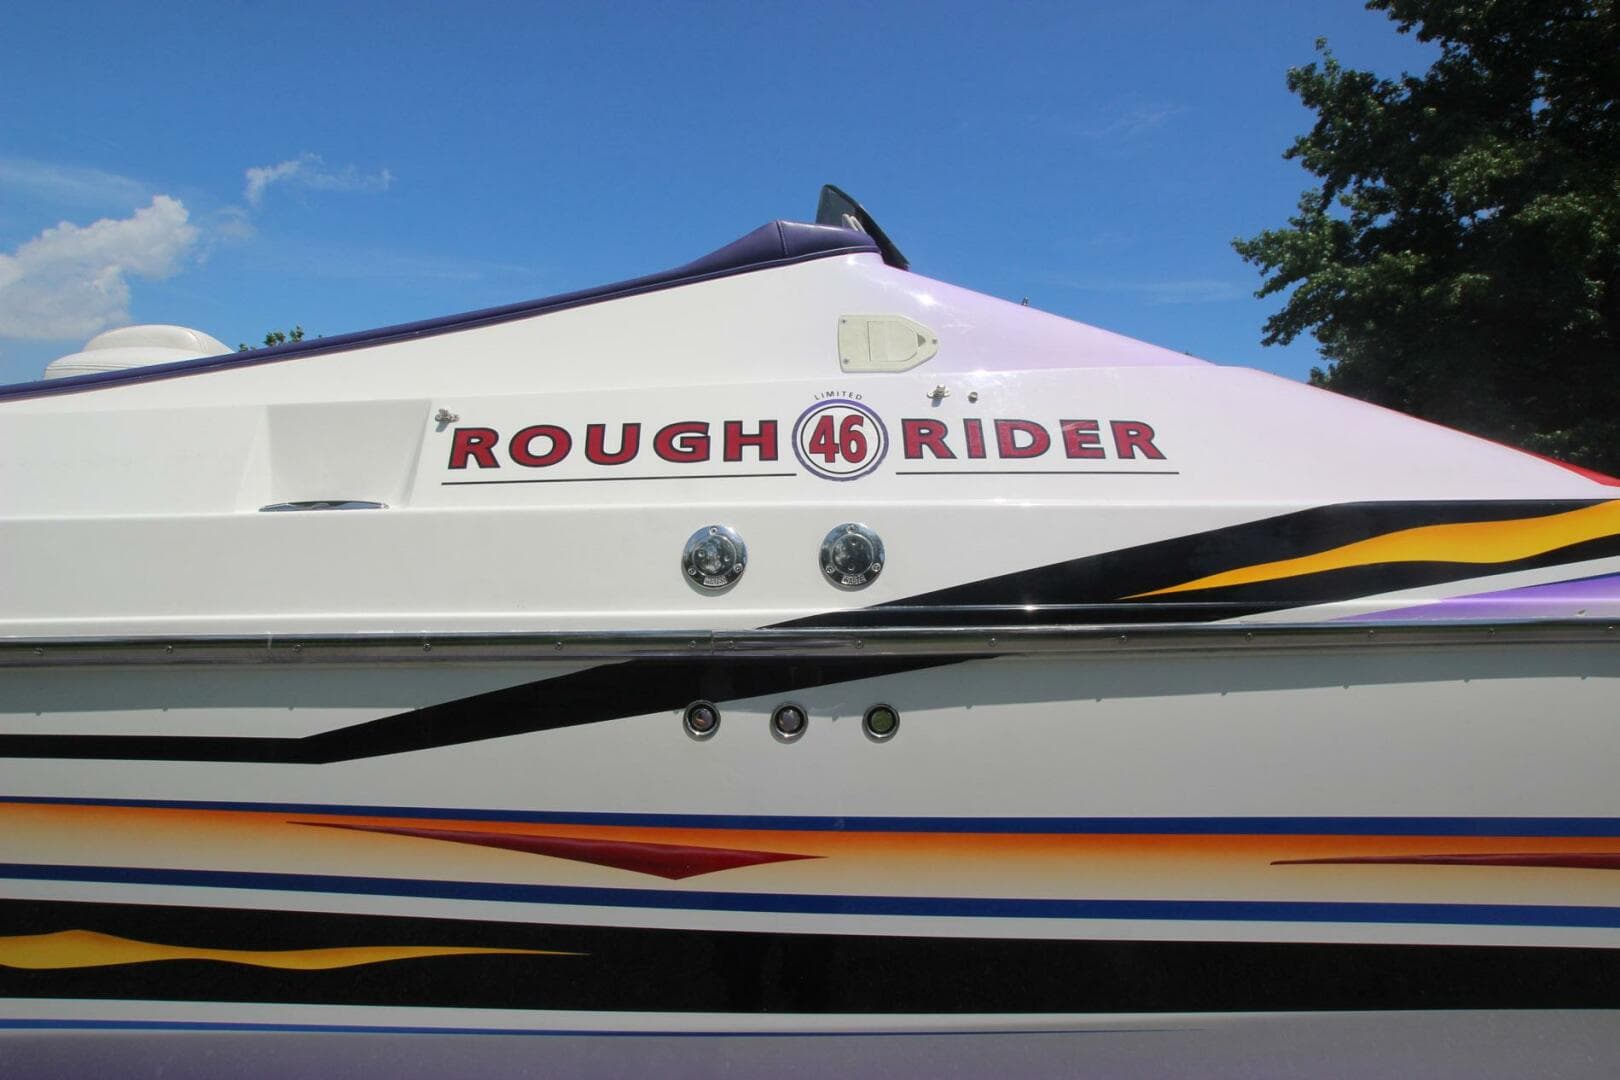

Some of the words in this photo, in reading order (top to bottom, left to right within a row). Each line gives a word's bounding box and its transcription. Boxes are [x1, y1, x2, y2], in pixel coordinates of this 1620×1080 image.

[813, 390, 863, 400] LIMITED
[448, 420, 778, 469] ROUGH
[808, 414, 868, 463] 46
[901, 418, 1167, 460] RIDER
